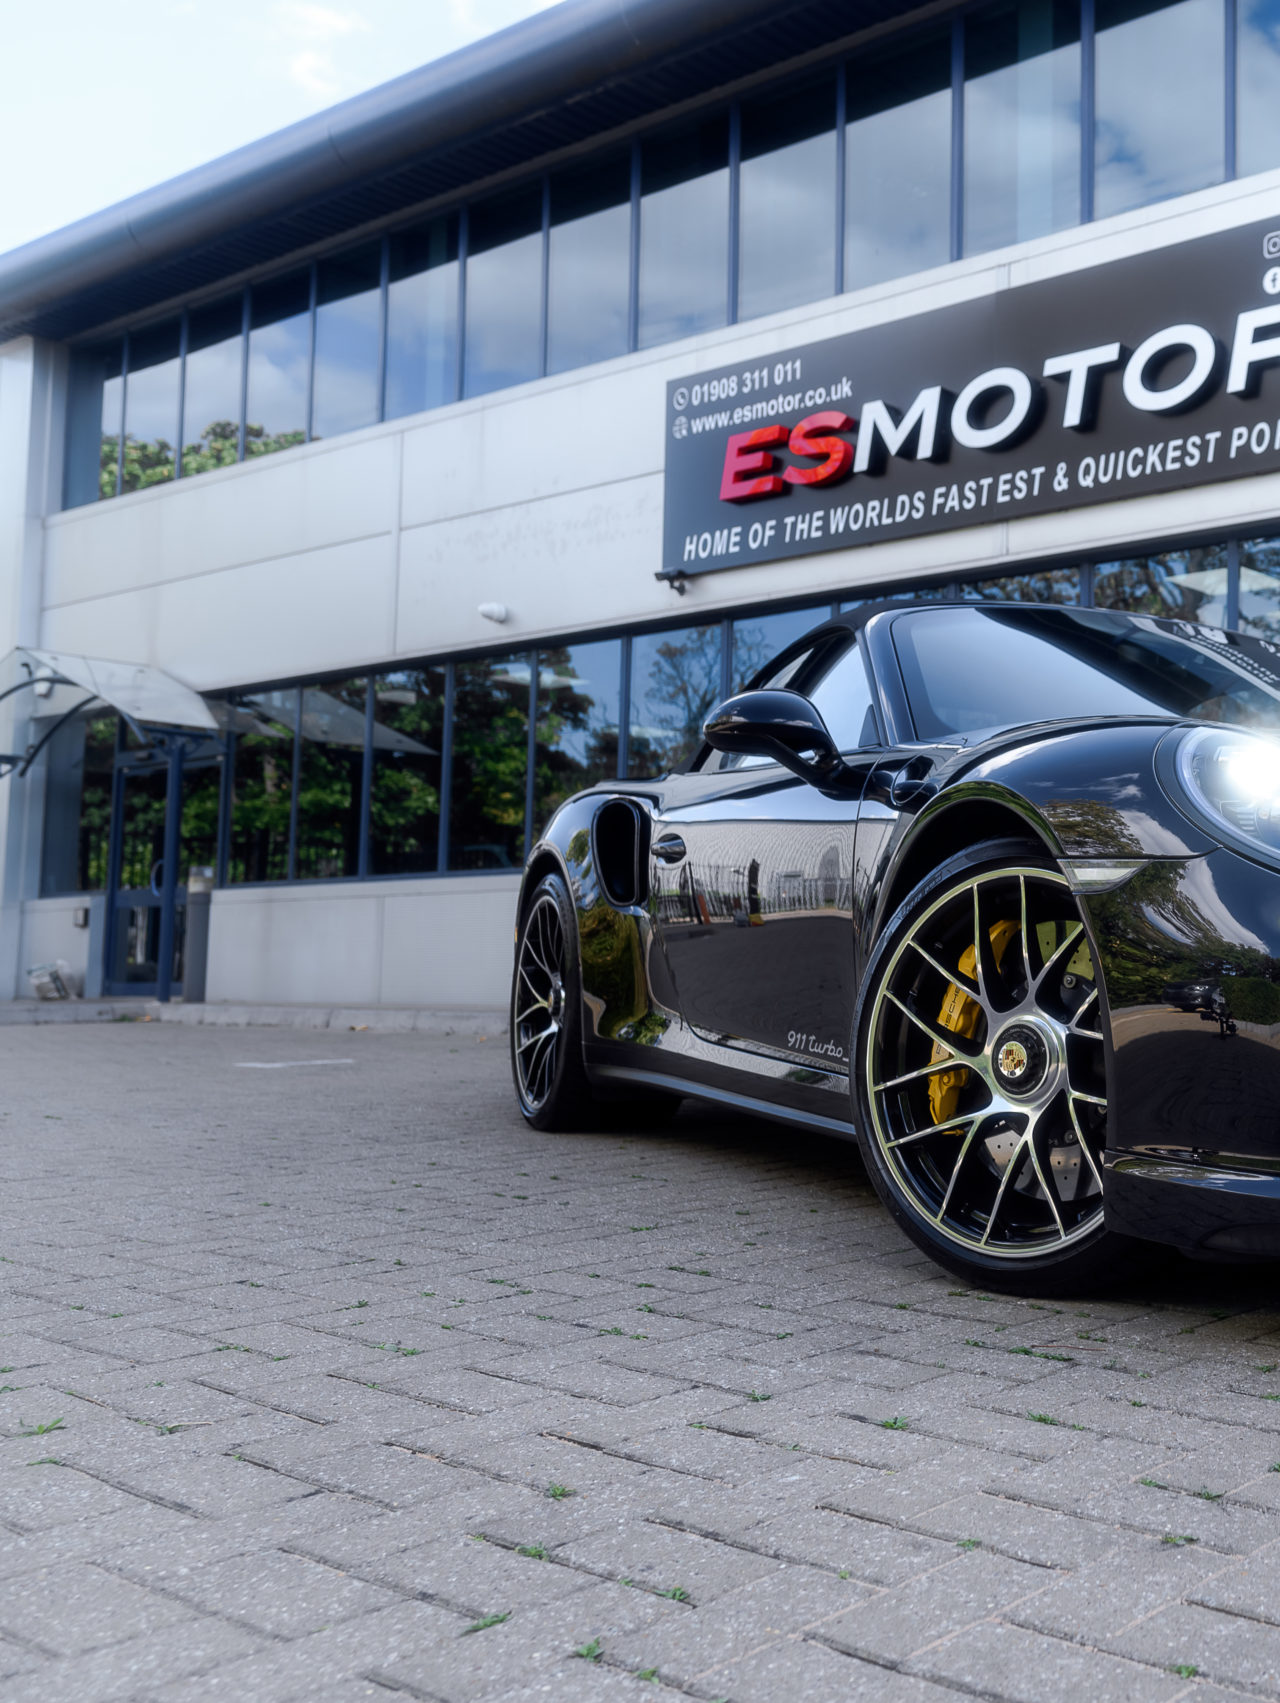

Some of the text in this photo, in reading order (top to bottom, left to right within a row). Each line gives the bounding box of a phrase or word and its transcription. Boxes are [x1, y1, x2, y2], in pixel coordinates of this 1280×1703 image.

[690, 376, 853, 435] www.esmotor.co.uk
[691, 358, 802, 407] 01908 311 011
[683, 526, 743, 562] HOME
[747, 519, 777, 550] OF
[783, 510, 825, 544] THE
[828, 490, 926, 535] WORLDS
[931, 466, 1046, 517] FASTEST
[1052, 461, 1070, 493] &
[1077, 431, 1222, 489] QUICKEST
[787, 1030, 807, 1051] 911
